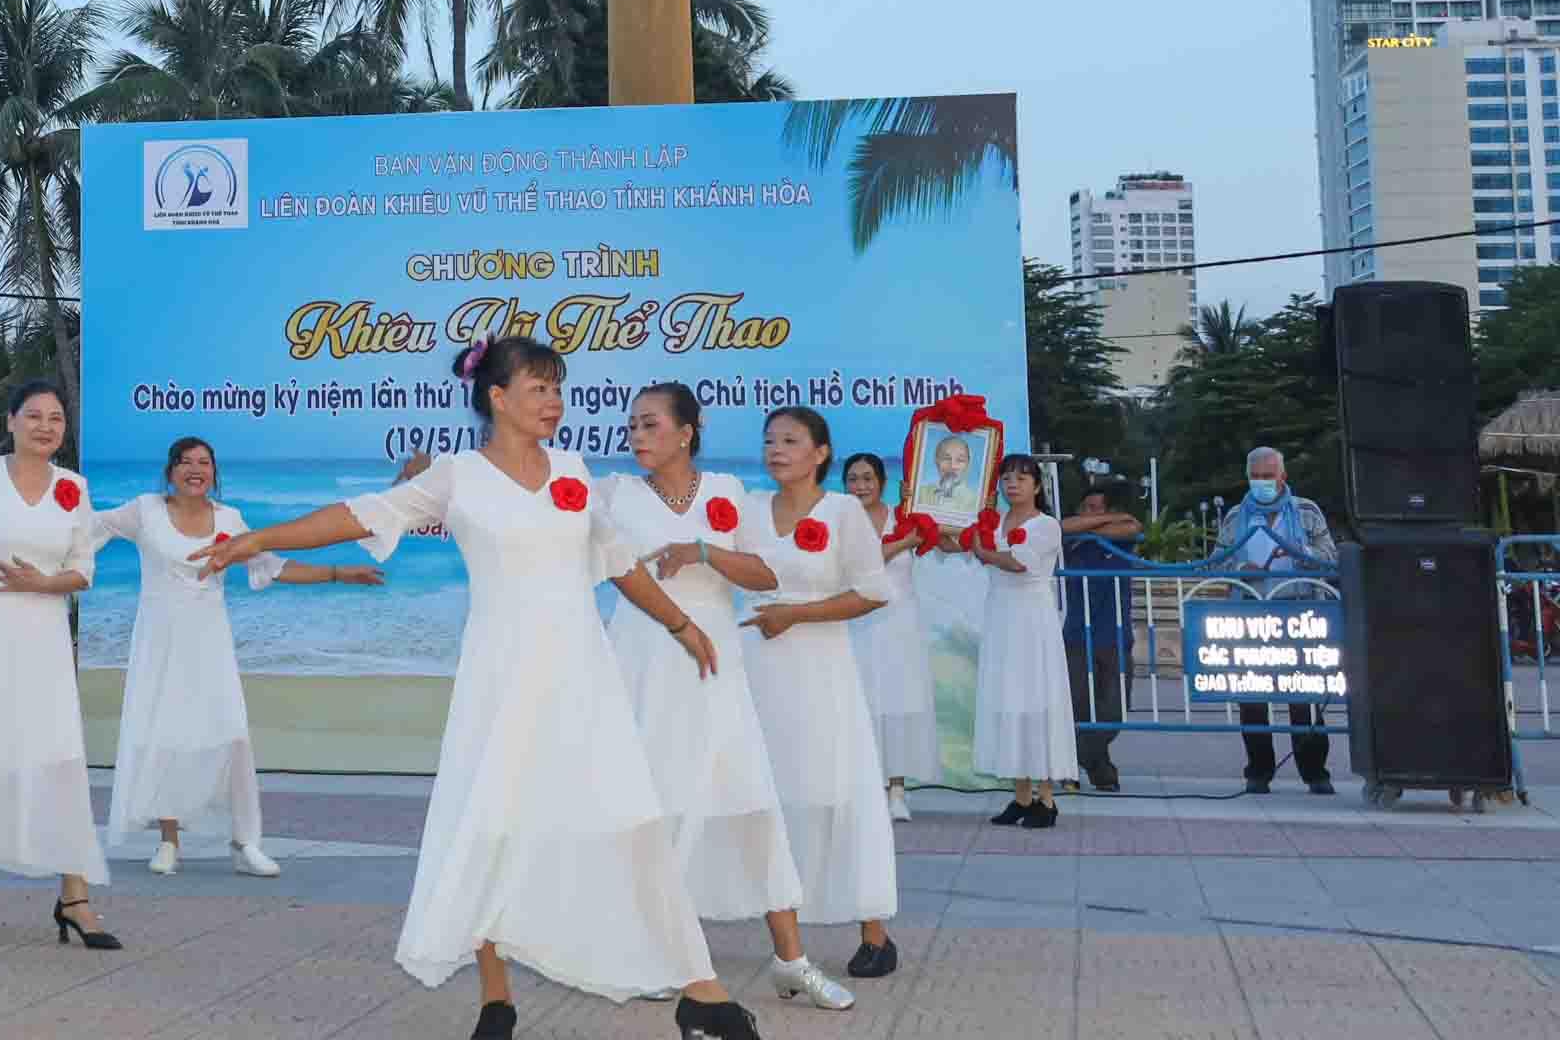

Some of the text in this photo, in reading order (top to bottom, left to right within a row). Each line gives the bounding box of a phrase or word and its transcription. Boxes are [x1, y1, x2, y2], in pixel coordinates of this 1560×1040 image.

[1368, 32, 1433, 48] STAR CITY
[375, 153, 420, 176] BAN
[482, 143, 548, 177] ĐỘNG
[556, 143, 636, 170] THÀNH
[644, 143, 688, 172] LẬP
[261, 176, 812, 217] LIÊN ĐOÀN KHIÊU VŨ THỂ THAO TỈNH KHÁNH HÒA
[407, 243, 659, 281] CHƯƠNG TRÌNH
[285, 300, 437, 359] Khiêu
[546, 293, 659, 354] Thể
[659, 292, 790, 353] Thao
[133, 380, 194, 410] Chào
[202, 380, 266, 417] mừng
[274, 378, 299, 414] kỷ
[307, 382, 363, 416] niệm
[371, 376, 407, 408] lần
[414, 381, 453, 408] thứ
[570, 377, 632, 415] ngày
[696, 375, 746, 407] Chủ
[754, 378, 800, 414] tịch
[809, 370, 843, 406] Hồ
[852, 376, 896, 406] Chí
[1246, 614, 1283, 642] VỰC
[1287, 610, 1328, 639] CẤM
